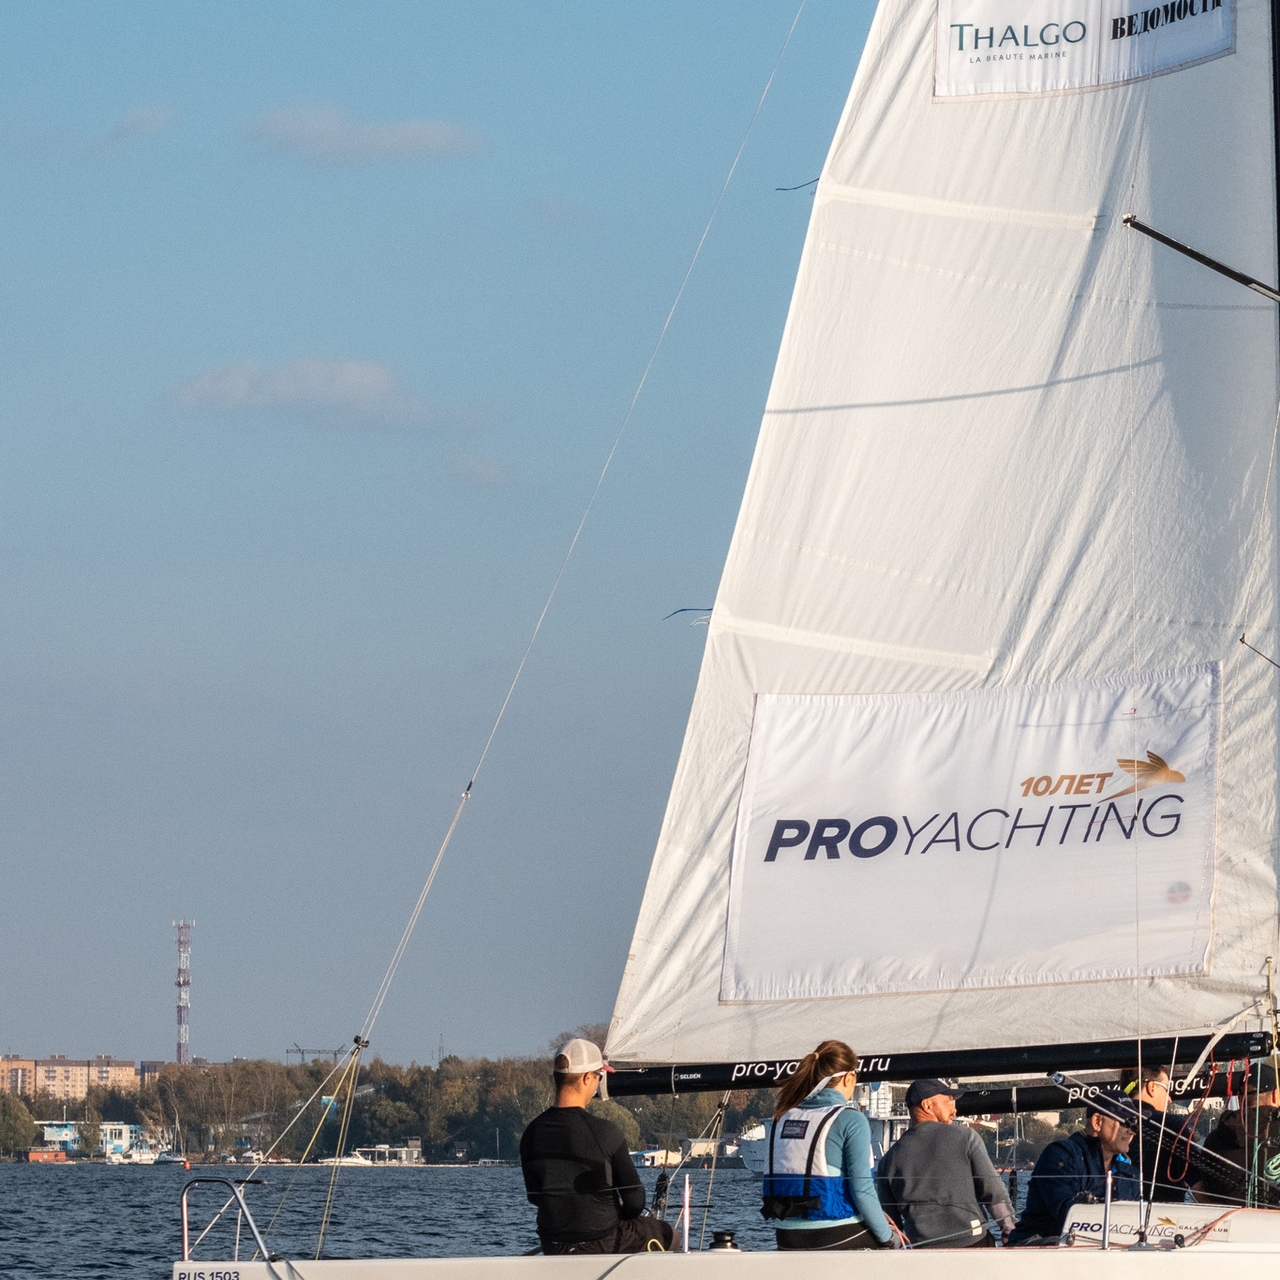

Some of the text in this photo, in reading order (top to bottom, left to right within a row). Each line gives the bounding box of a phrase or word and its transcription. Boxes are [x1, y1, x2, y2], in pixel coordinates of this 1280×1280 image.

[969, 56, 982, 64] LA
[1029, 50, 1067, 61] MARINE
[763, 794, 1185, 863] PROYACHTING
